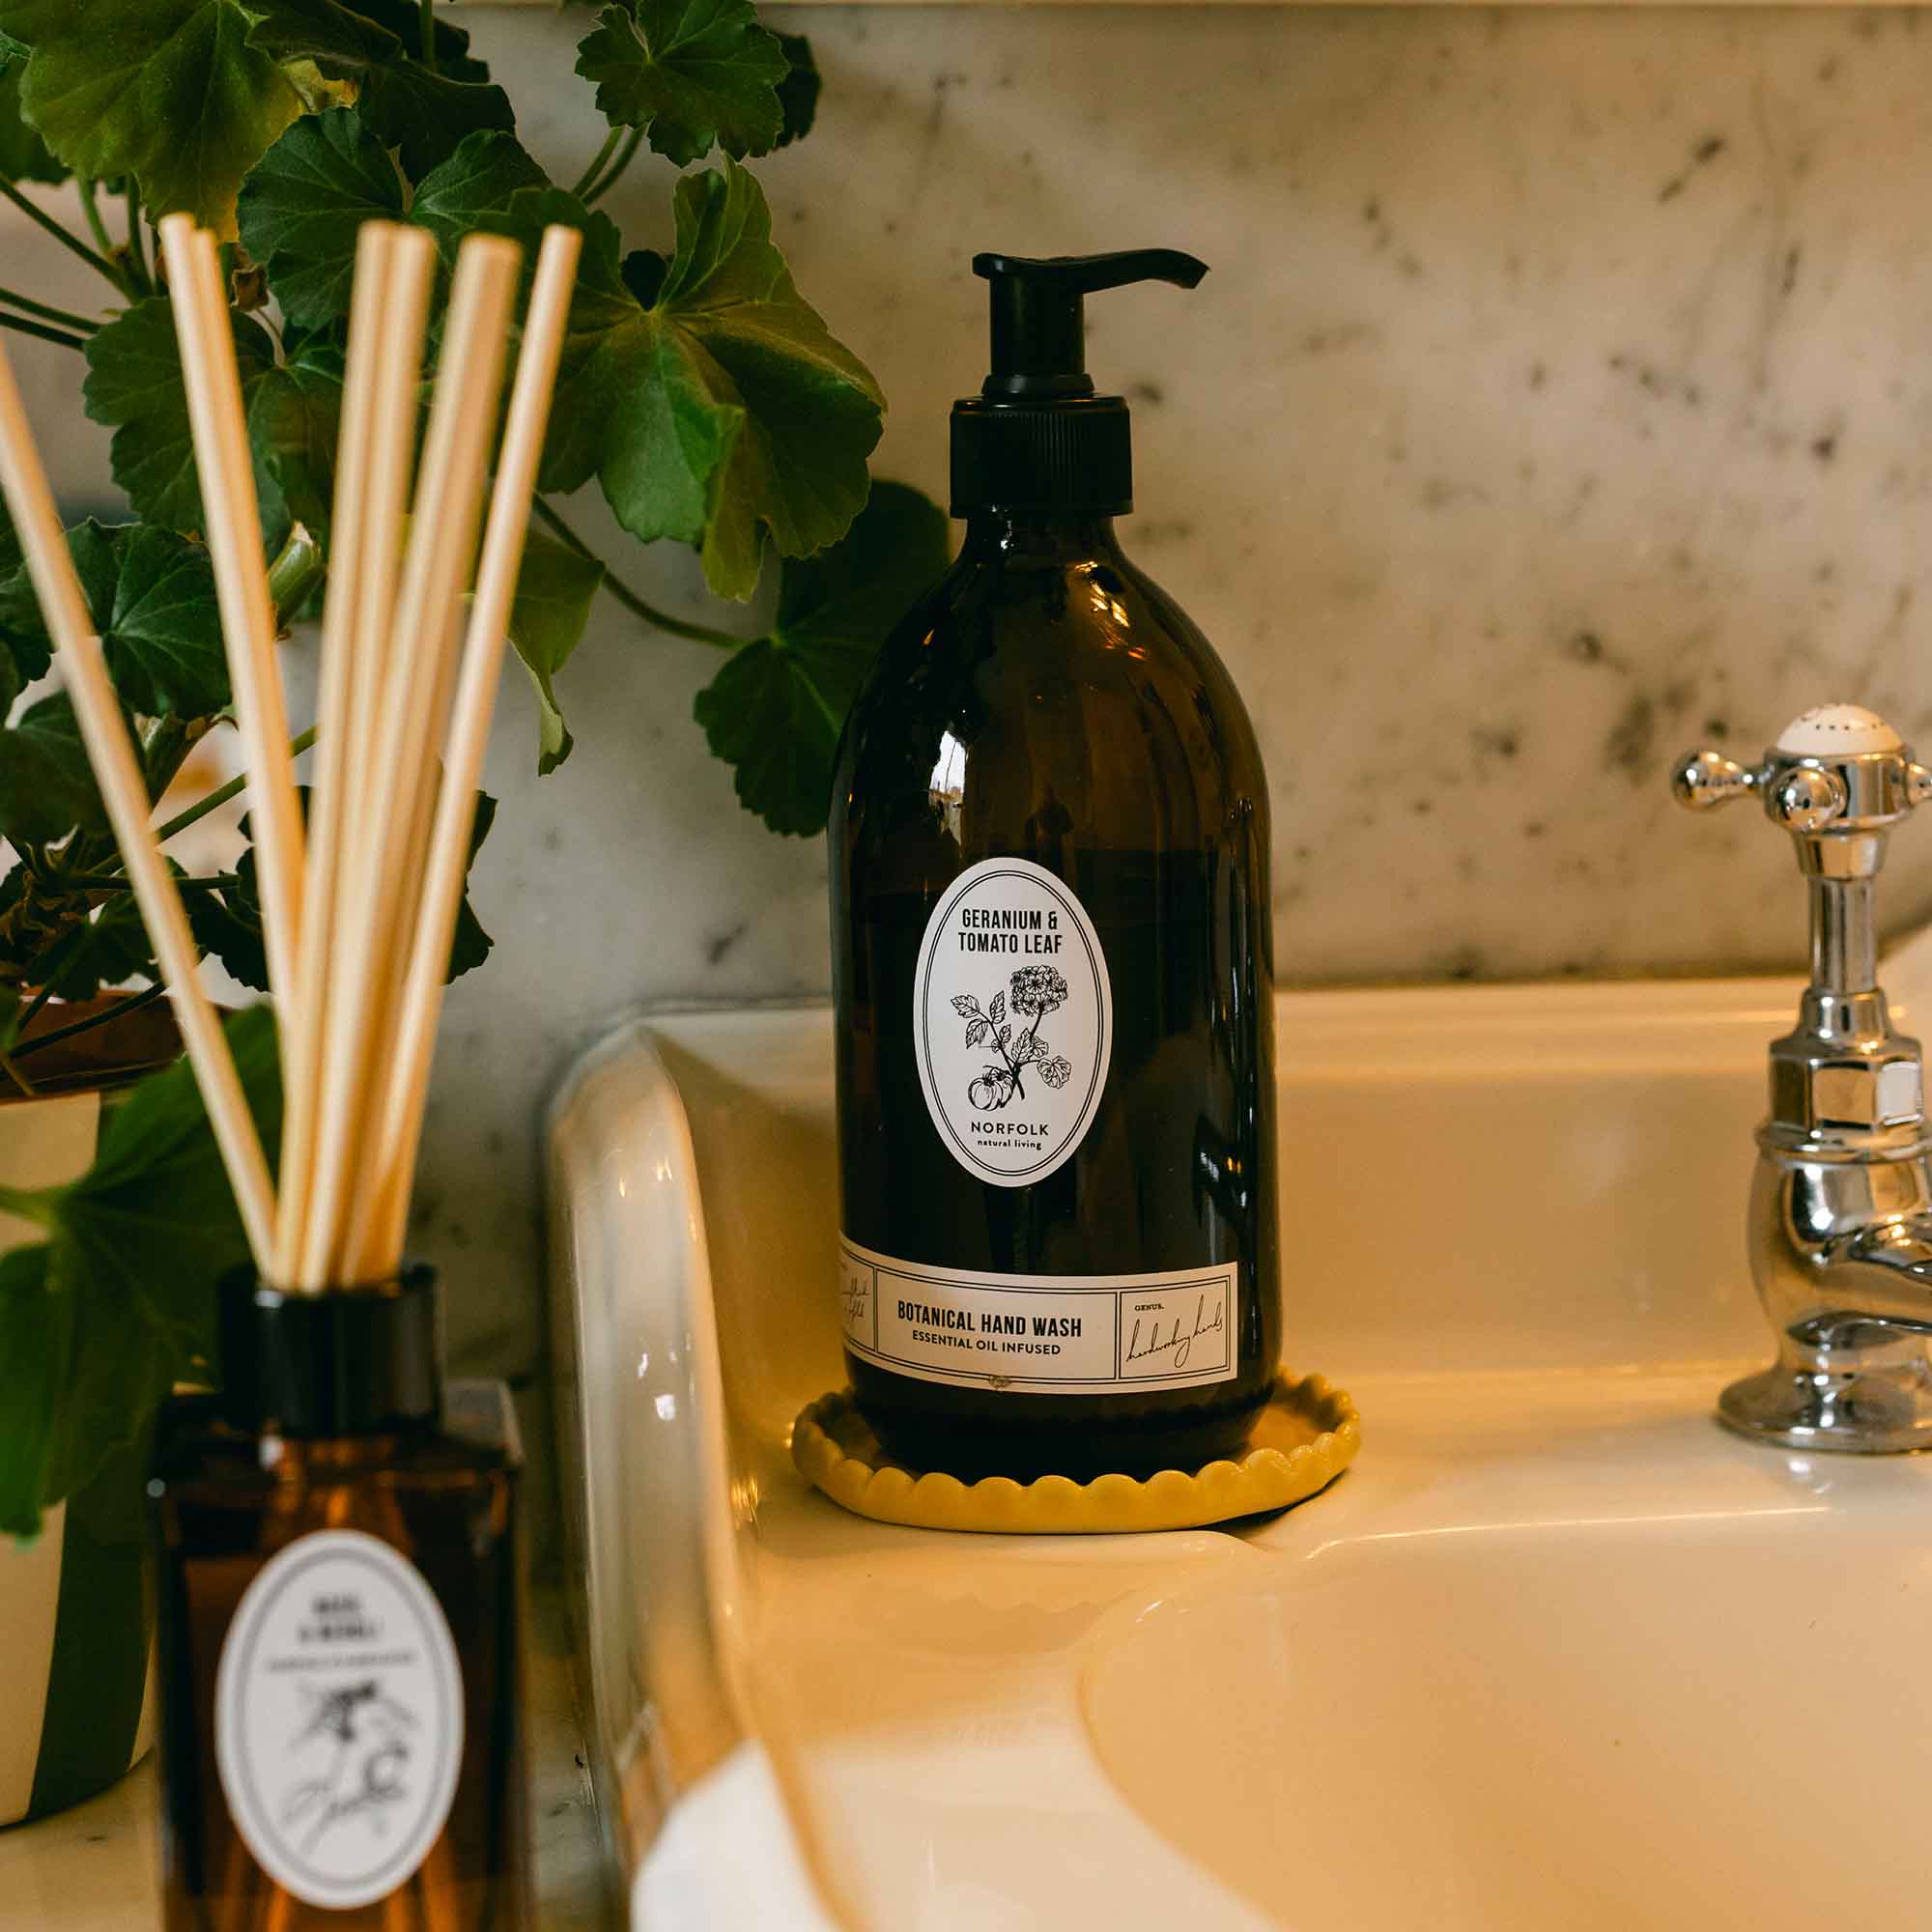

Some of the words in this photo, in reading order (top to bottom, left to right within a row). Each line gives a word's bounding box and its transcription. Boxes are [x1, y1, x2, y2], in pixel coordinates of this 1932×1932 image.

[962, 908, 1041, 929] GERANIUM
[1048, 911, 1058, 930] &
[958, 932, 1019, 953] TOMATO
[1025, 935, 1063, 953] LEAF
[971, 1122, 1049, 1135] NORFOLK
[1014, 1140, 1041, 1151] living
[897, 1300, 975, 1331] BOTANICAL
[981, 1314, 1026, 1335] HAND
[1033, 1318, 1082, 1337] WASH
[912, 1329, 973, 1350] ESSENTIAL
[976, 1340, 997, 1351] OIL
[1002, 1342, 1062, 1355] INFUSED
